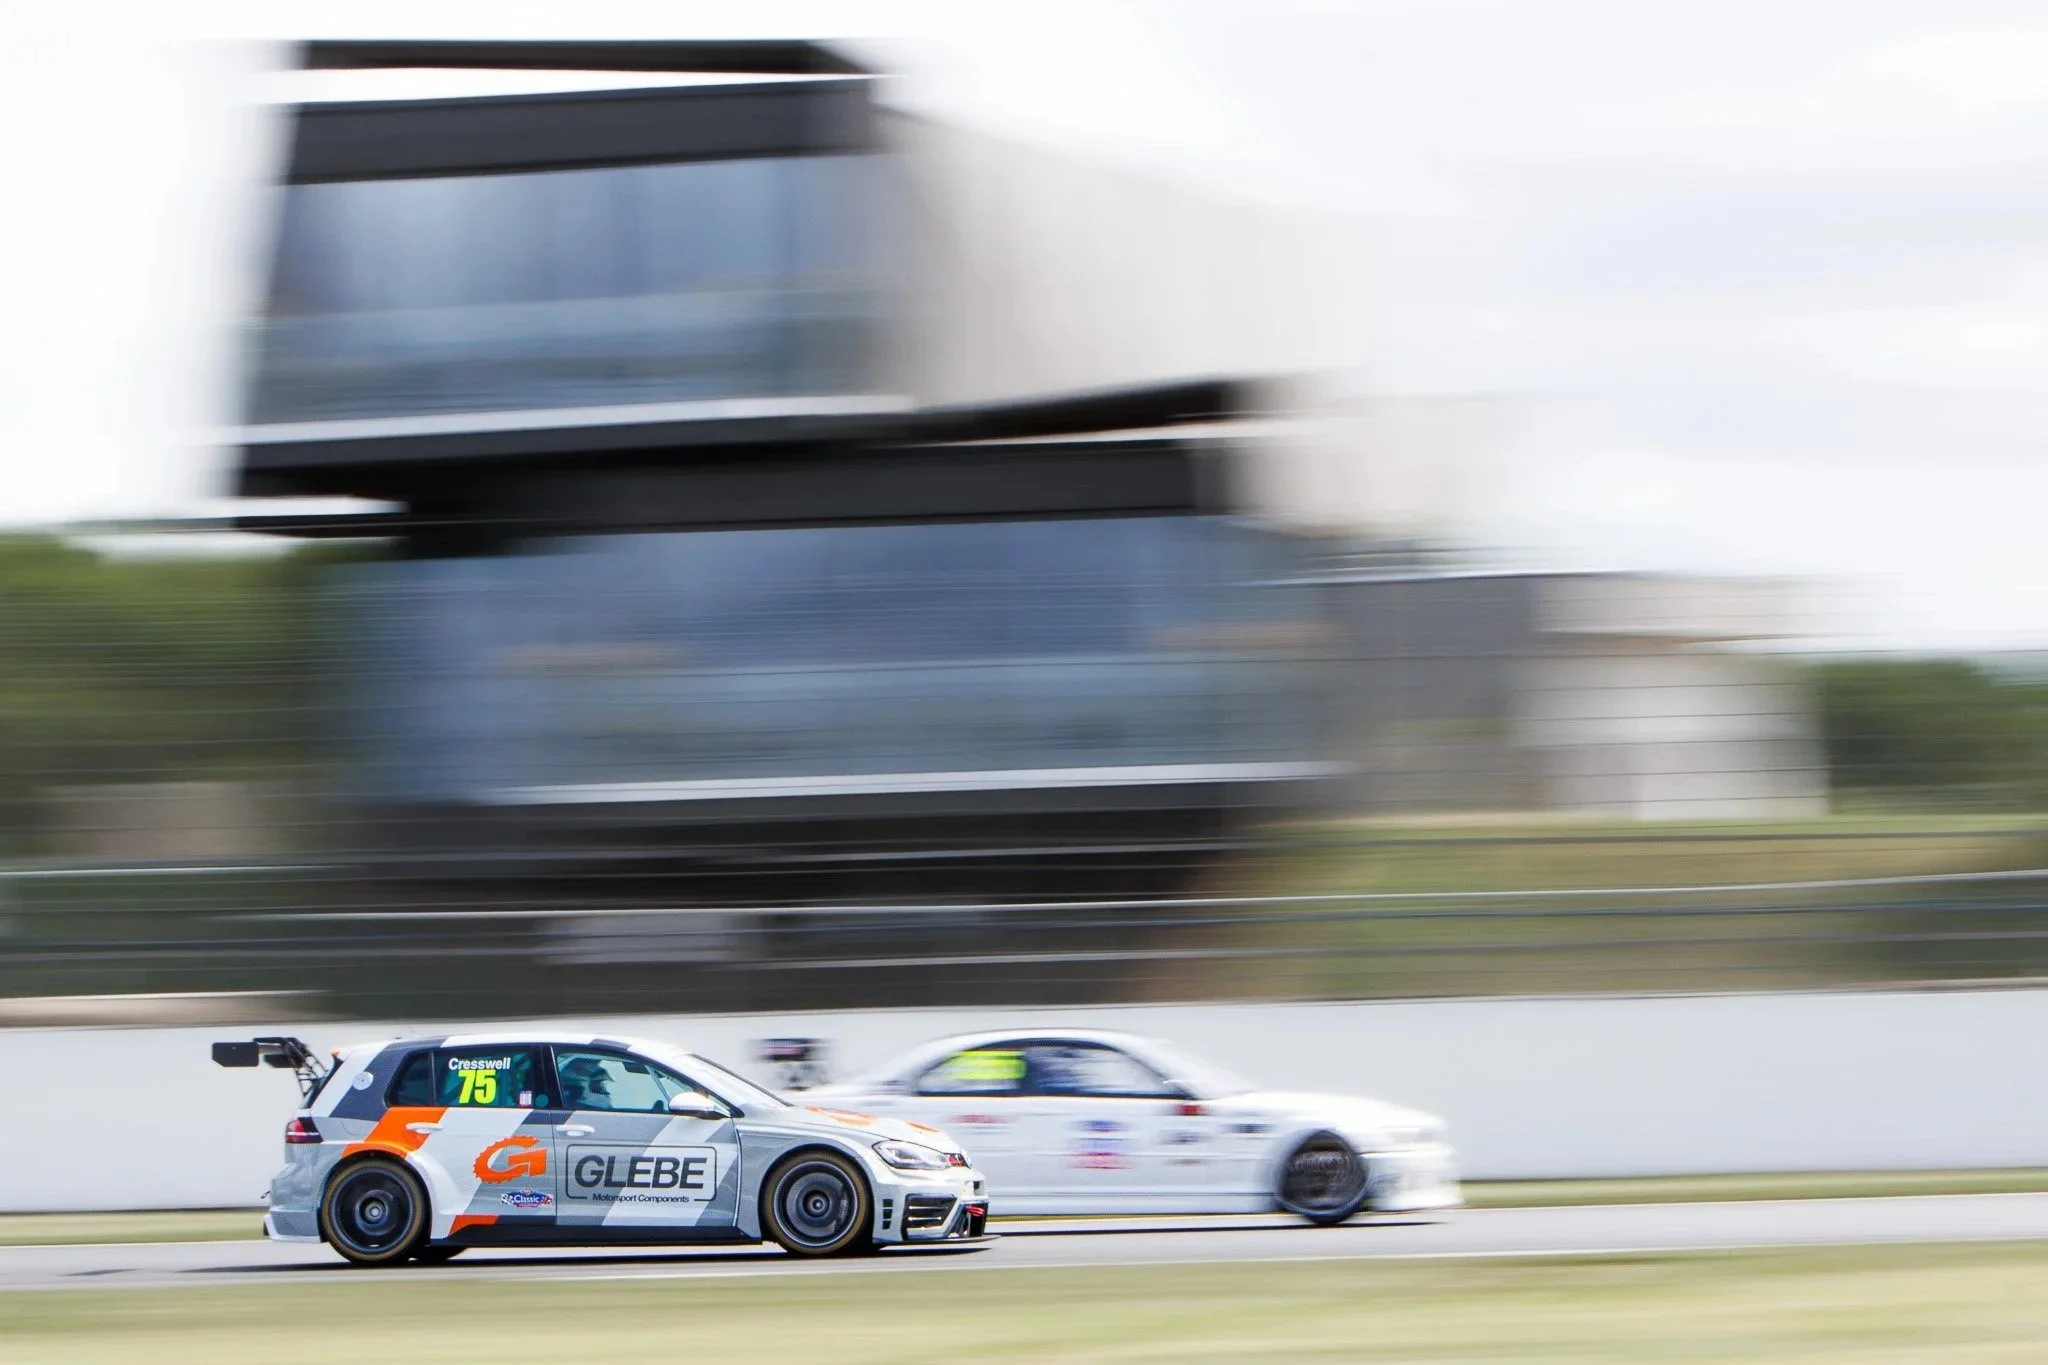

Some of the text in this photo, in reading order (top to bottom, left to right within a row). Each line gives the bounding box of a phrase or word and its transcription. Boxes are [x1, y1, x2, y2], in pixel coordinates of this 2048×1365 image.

[448, 1057, 511, 1070] Cresswell
[458, 1069, 496, 1104] 75
[574, 1154, 708, 1189] GLEBE
[513, 1194, 541, 1203] Classic
[592, 1193, 690, 1204] Motorsport Components
